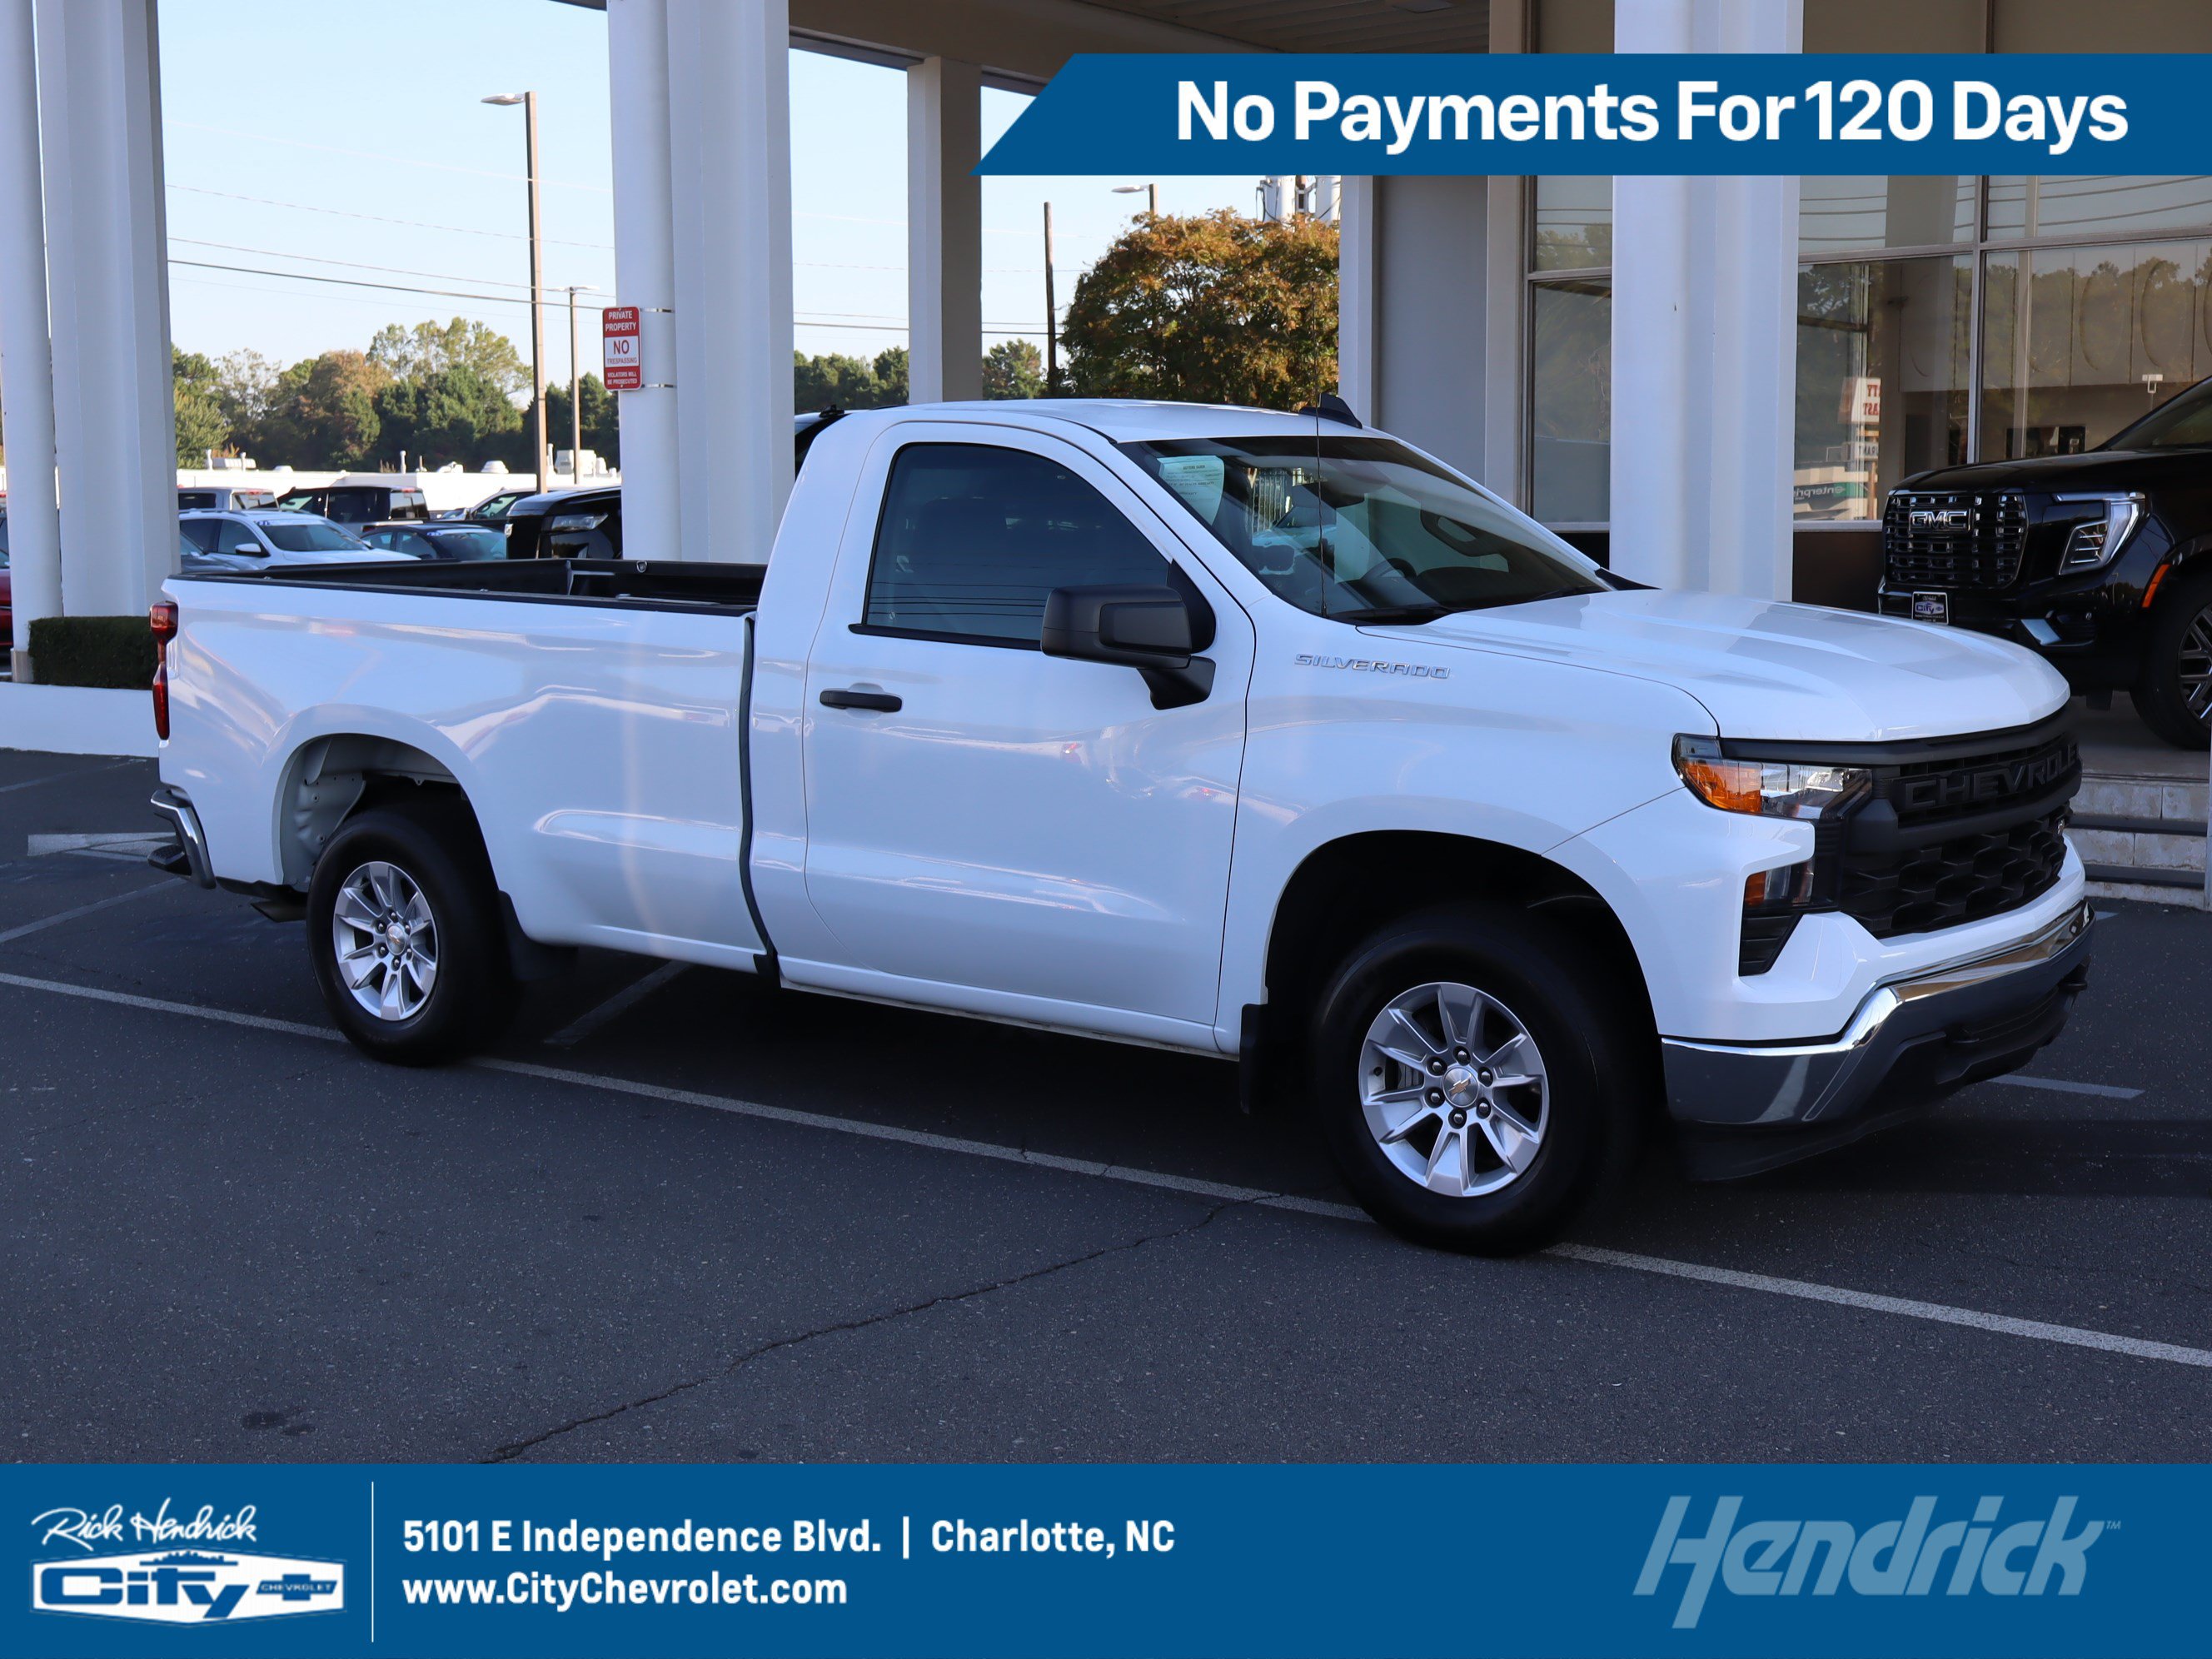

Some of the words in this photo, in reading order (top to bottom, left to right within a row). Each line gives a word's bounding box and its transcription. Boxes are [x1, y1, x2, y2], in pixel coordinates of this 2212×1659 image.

[609, 311, 632, 319] PRIVATE
[605, 322, 636, 331] PROPERTY
[614, 340, 629, 354] NO
[1911, 510, 1968, 530] GMC
[1293, 654, 1452, 679] SILVERADO
